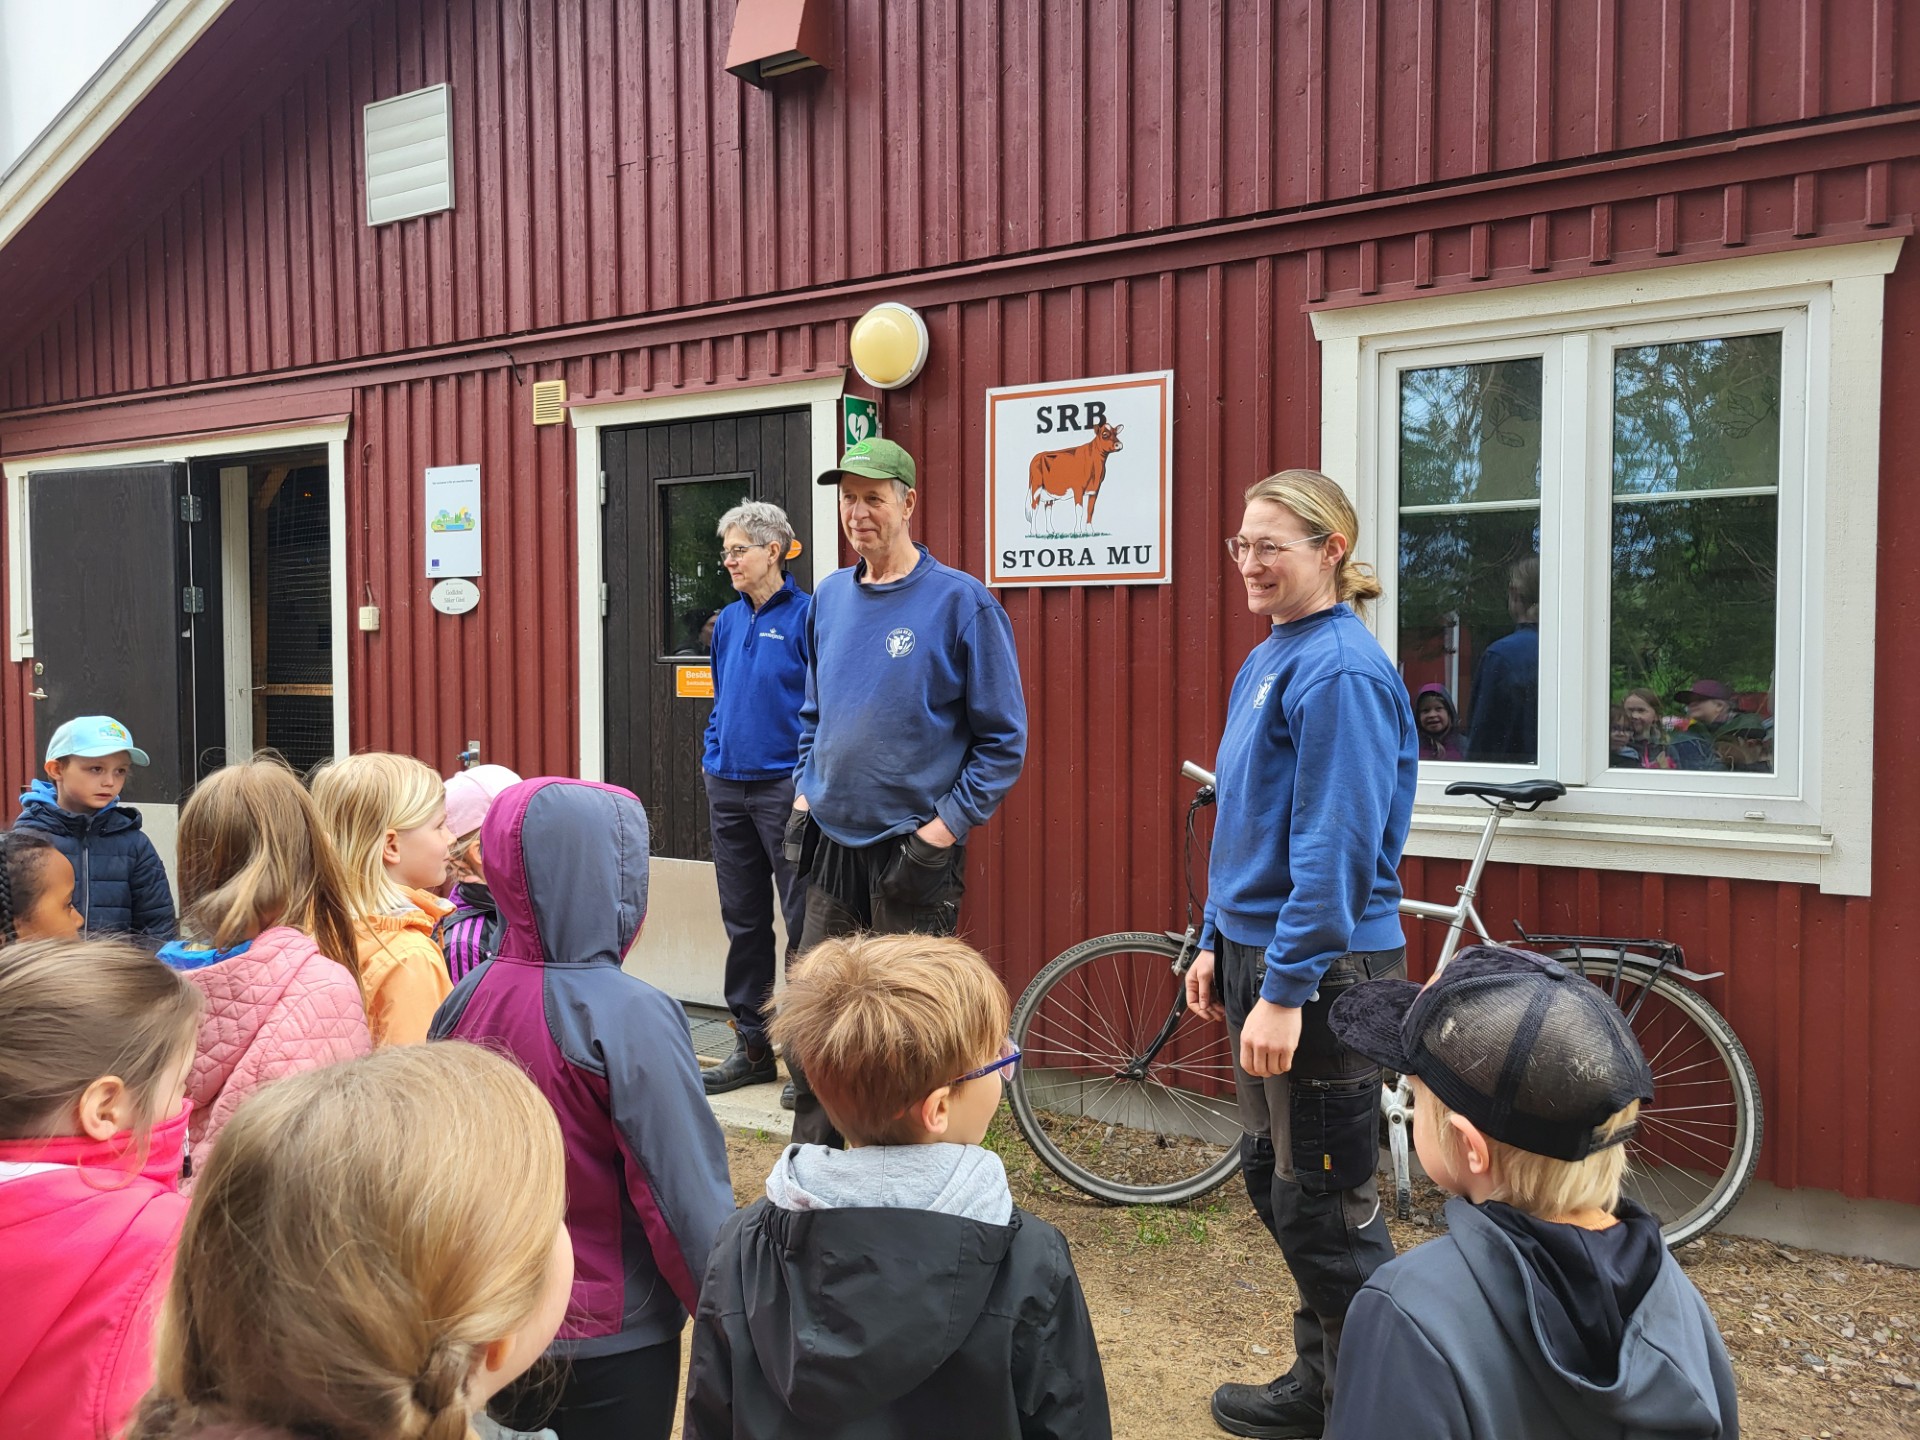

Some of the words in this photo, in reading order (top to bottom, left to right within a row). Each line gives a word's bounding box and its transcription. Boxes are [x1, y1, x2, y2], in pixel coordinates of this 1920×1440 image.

[1036, 401, 1107, 434] SRB
[1002, 547, 1095, 569] STORA
[1107, 544, 1153, 566] MU
